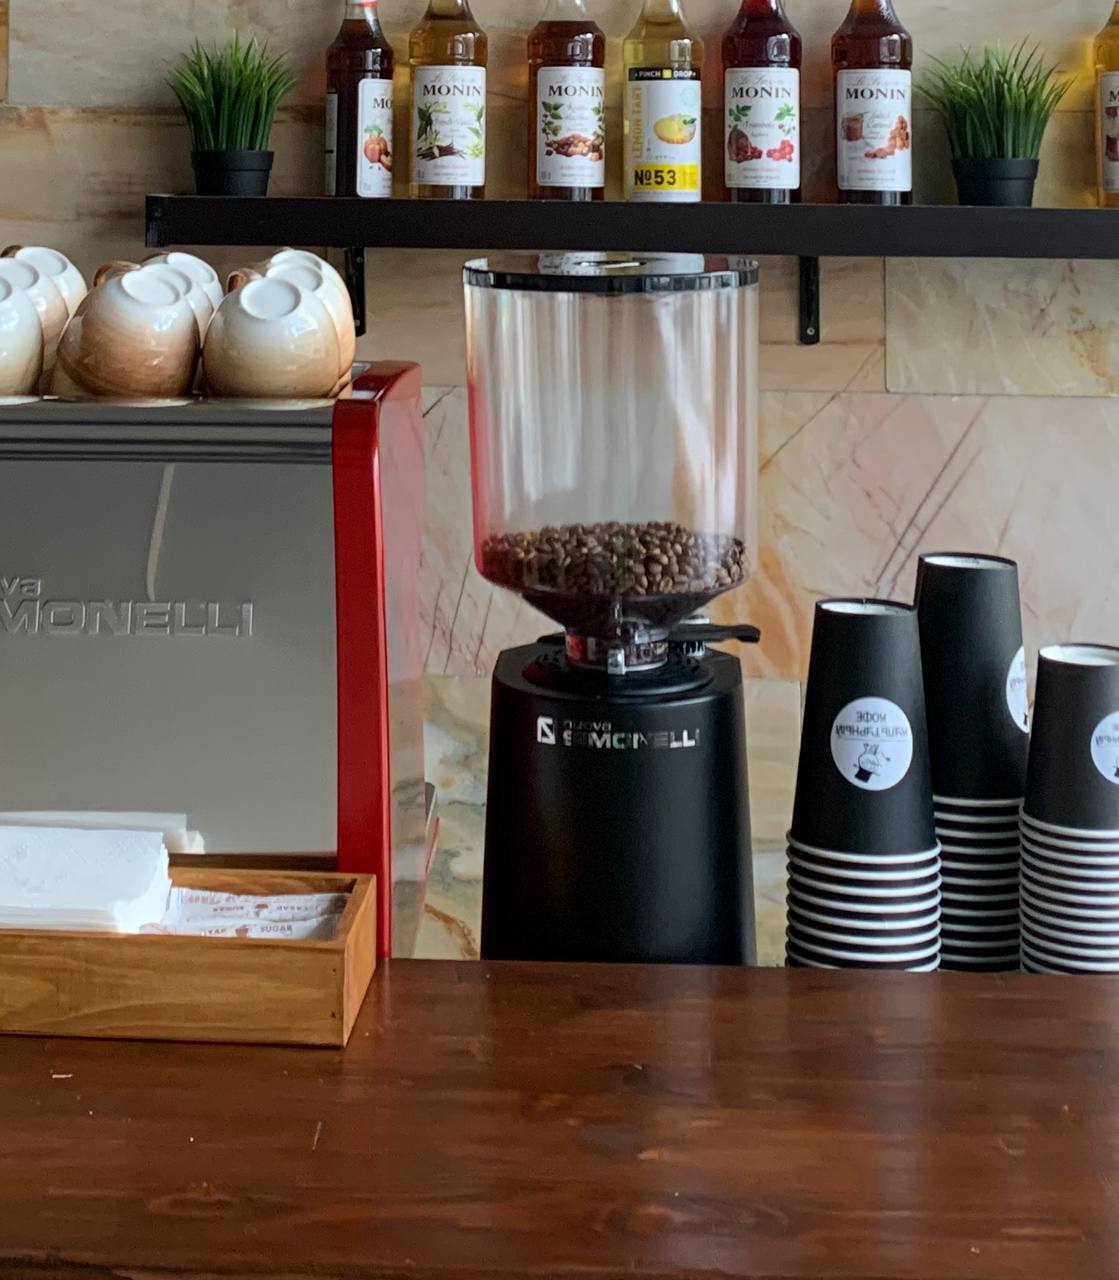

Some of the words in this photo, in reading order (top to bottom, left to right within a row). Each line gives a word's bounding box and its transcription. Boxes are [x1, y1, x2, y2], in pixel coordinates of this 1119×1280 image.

[423, 84, 482, 97] MONIN
[731, 86, 792, 99] MONIN
[845, 87, 906, 100] MONIN
